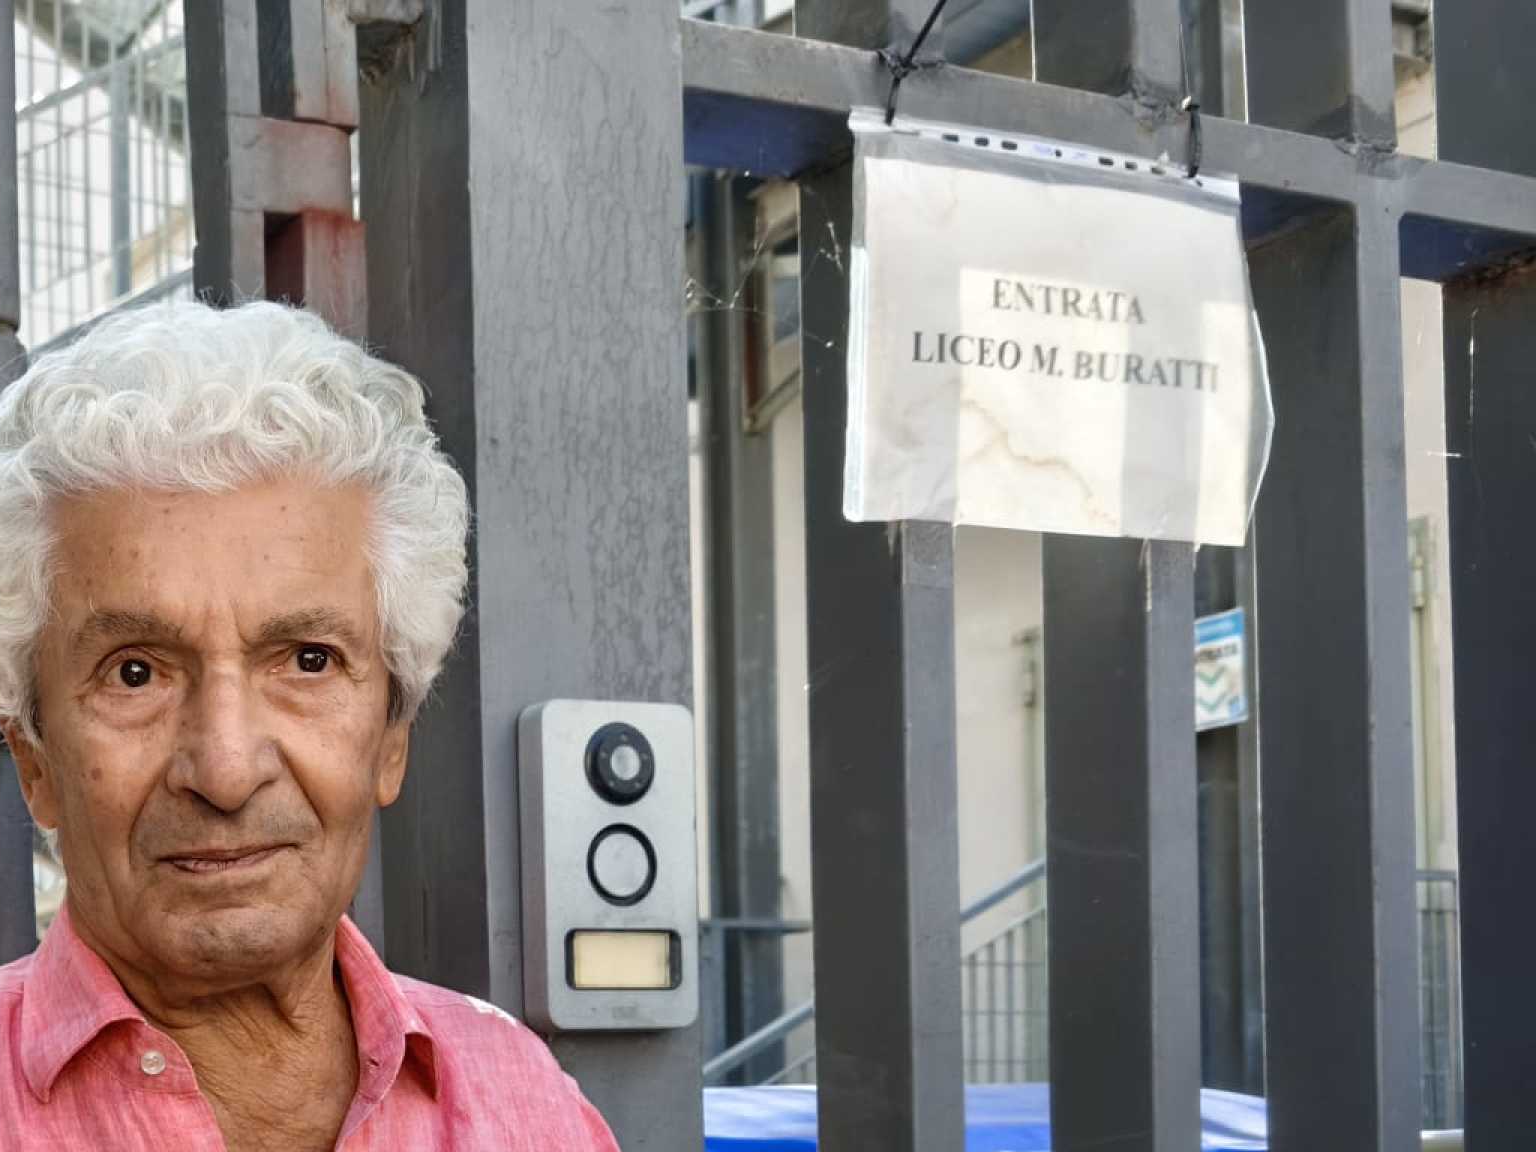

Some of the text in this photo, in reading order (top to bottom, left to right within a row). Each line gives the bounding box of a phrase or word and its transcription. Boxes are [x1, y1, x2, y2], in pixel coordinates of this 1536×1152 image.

[992, 278, 1146, 325] ENTRATA
[911, 331, 1219, 393] LICEO M. BURATTI
